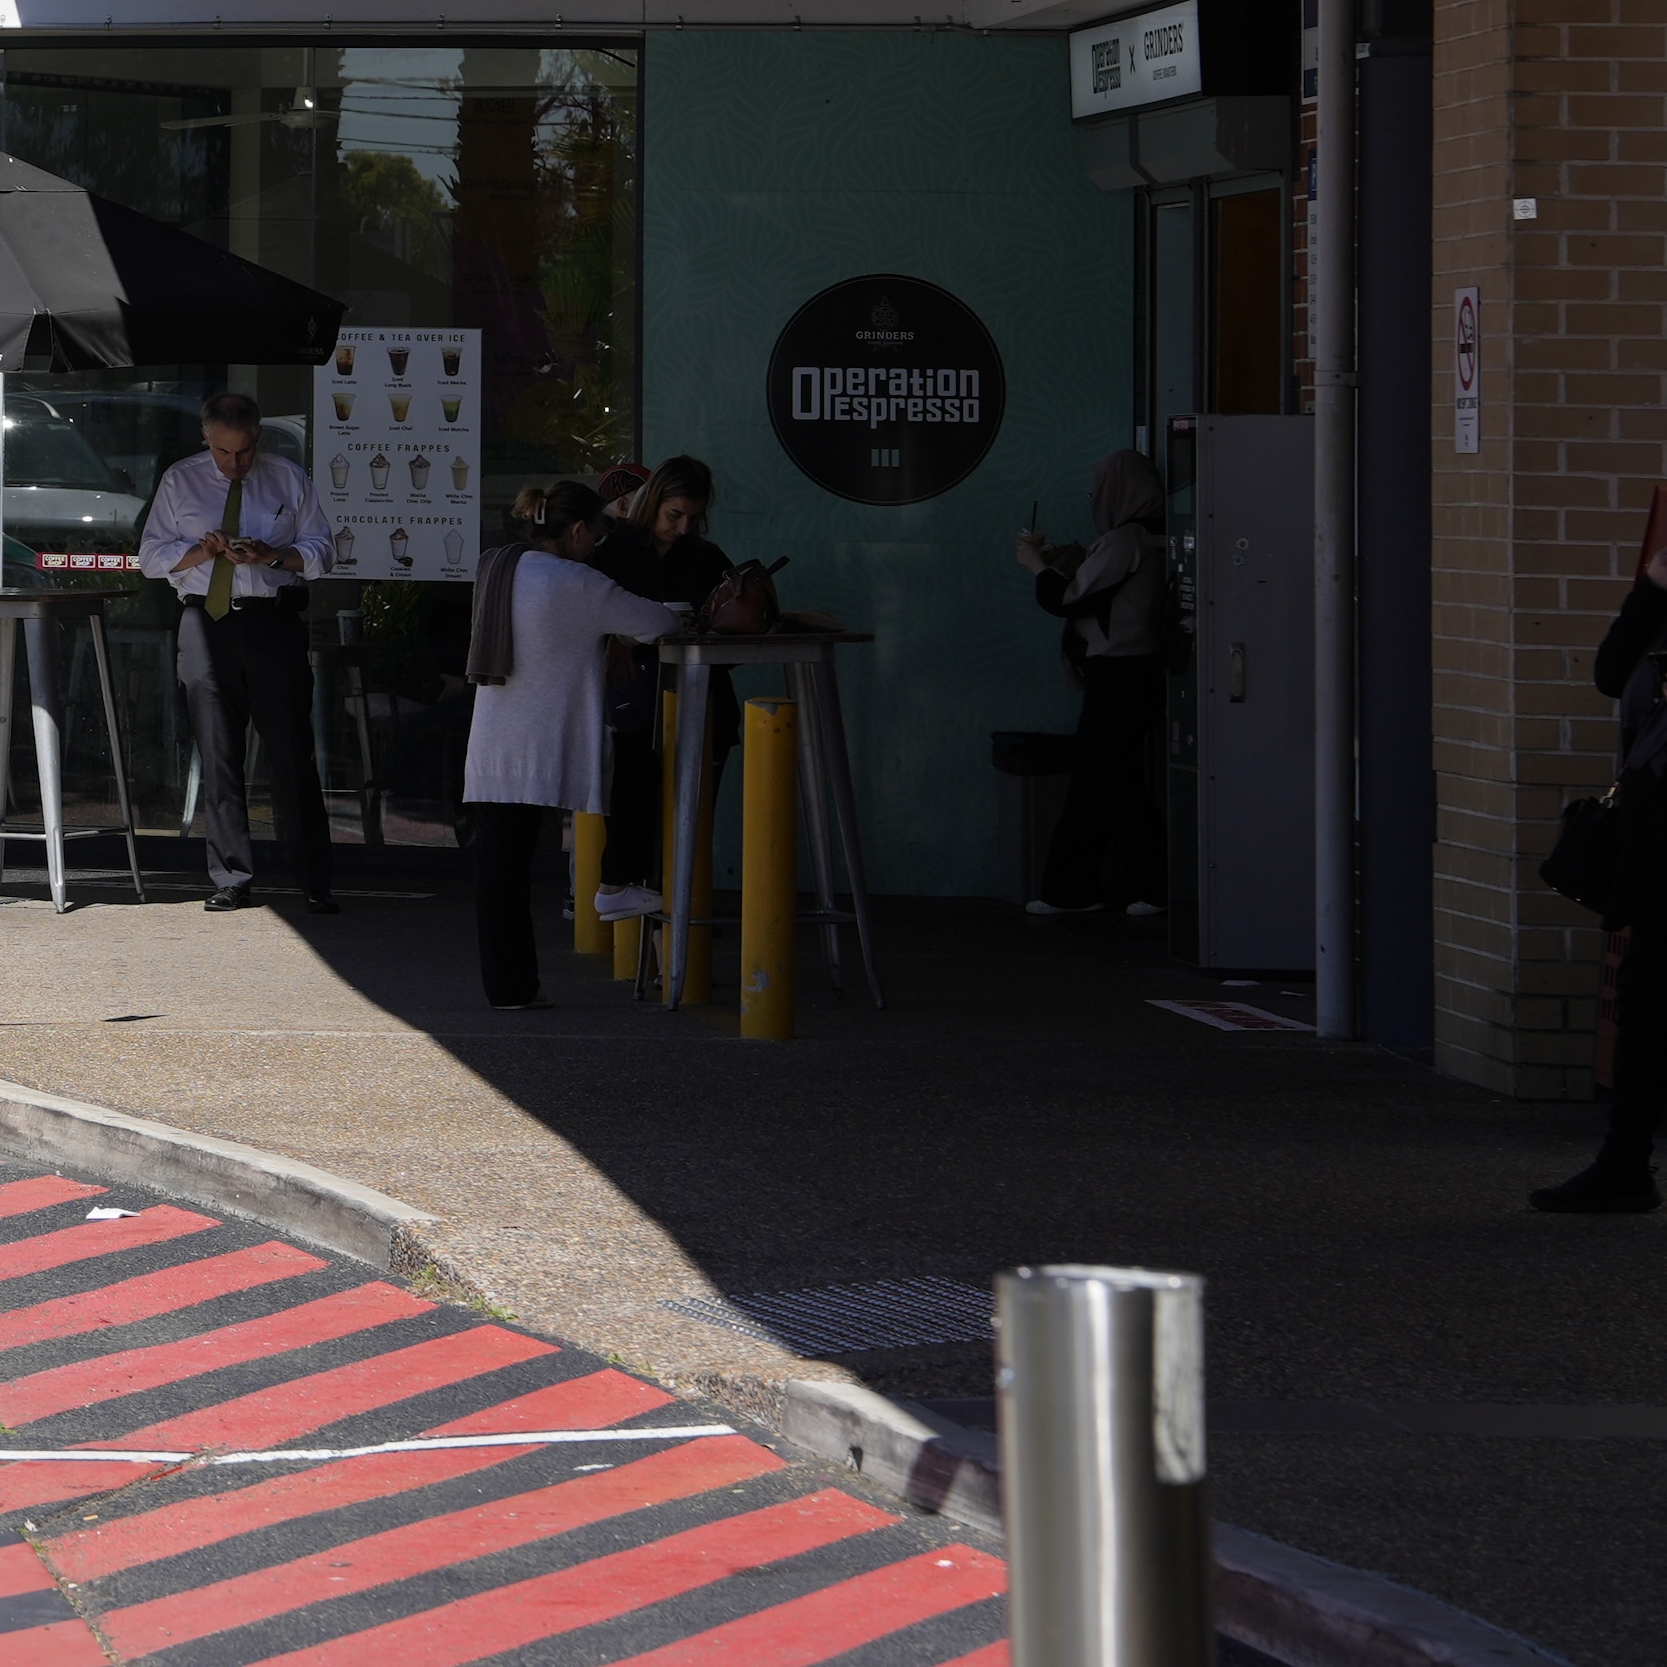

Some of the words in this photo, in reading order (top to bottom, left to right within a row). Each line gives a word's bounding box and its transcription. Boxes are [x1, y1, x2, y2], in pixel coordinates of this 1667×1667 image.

[1144, 24, 1183, 61] GRINDERS
[417, 334, 443, 342] OVER
[449, 334, 466, 342] ICE
[855, 330, 915, 340] GRINDERS
[792, 367, 980, 420] Operation
[834, 396, 980, 430] Espresso
[347, 443, 391, 451] COFFEE
[397, 444, 450, 452] FRAPPES
[336, 515, 403, 524] CHOCOLATE
[410, 517, 463, 525] FRAPPES
